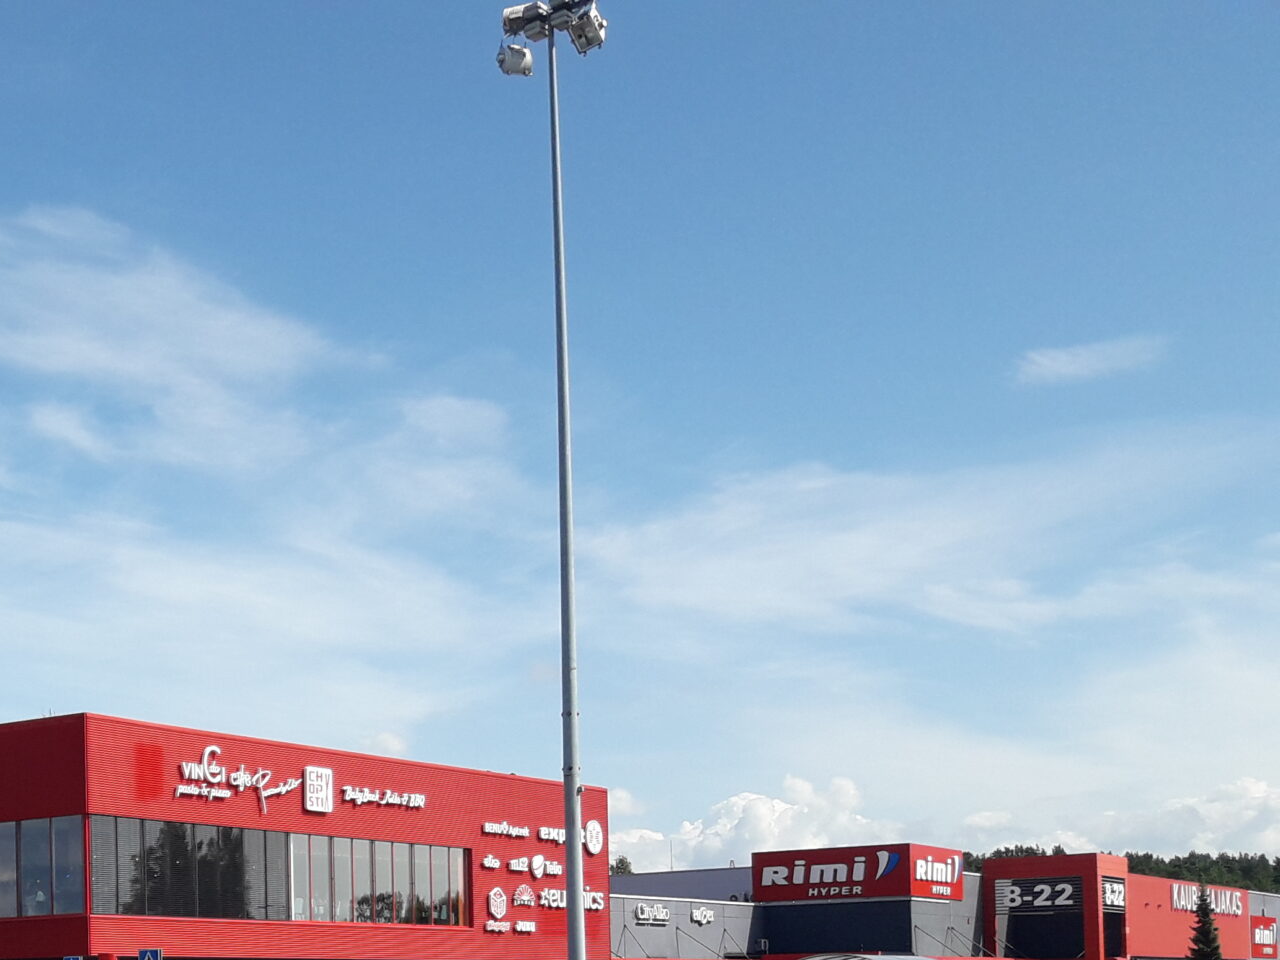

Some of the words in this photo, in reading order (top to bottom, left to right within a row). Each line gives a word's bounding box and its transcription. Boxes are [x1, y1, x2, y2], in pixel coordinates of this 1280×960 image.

[761, 856, 866, 886] Rimi
[916, 856, 952, 883] Rimi
[808, 886, 863, 897] HYPER
[1004, 883, 1074, 907] 8-22
[1105, 882, 1125, 907] 8-22
[1172, 883, 1242, 916] KAUBAJAKAS
